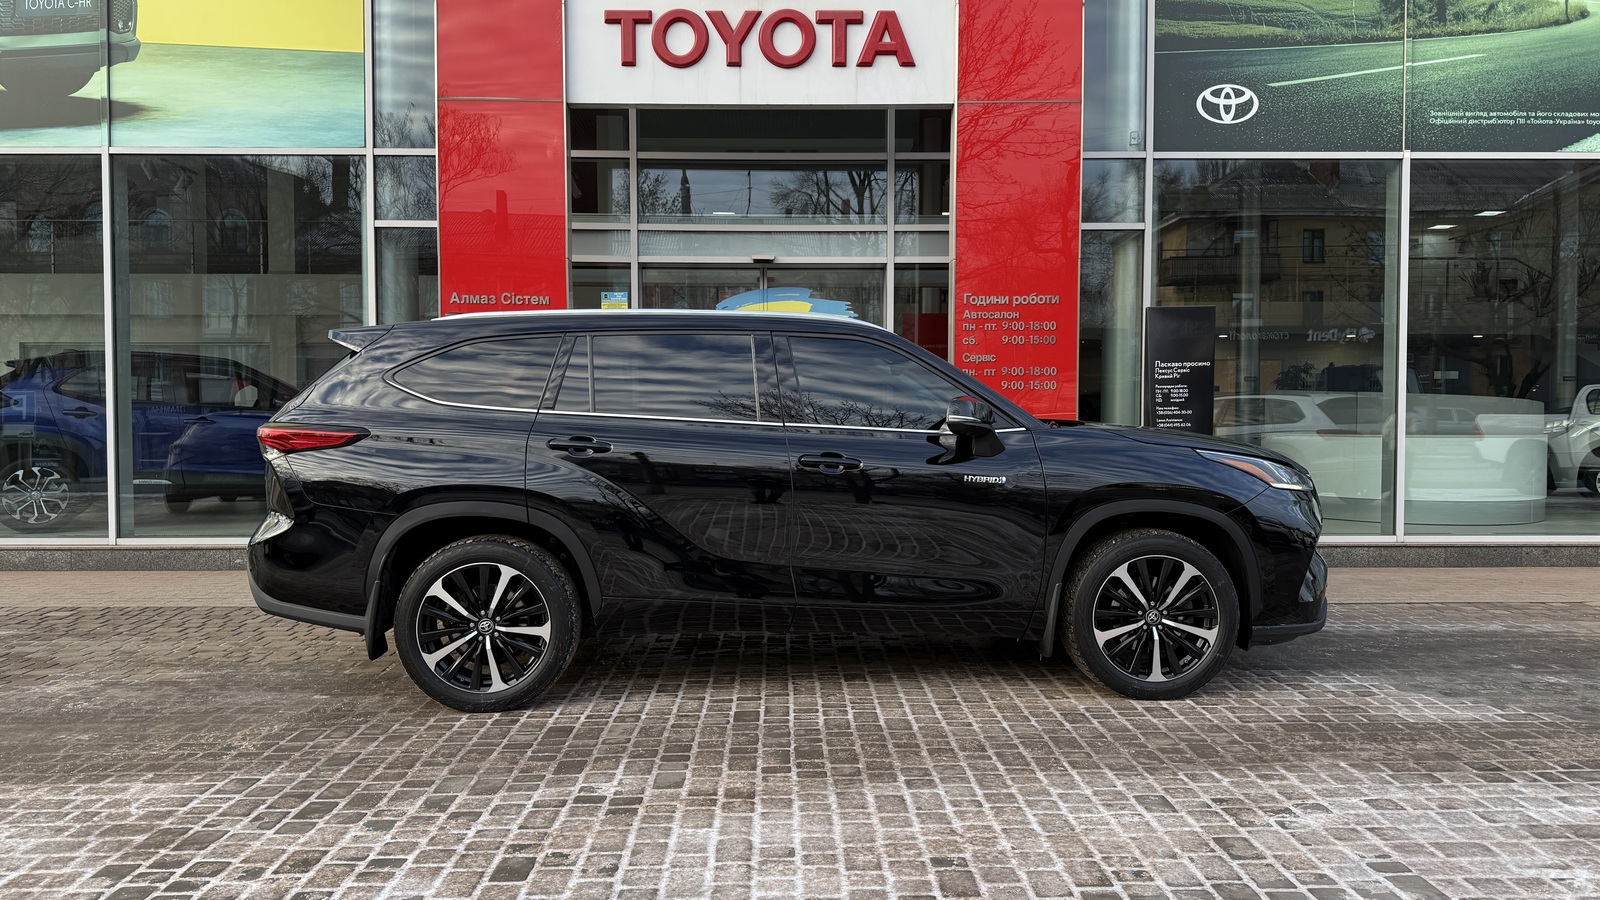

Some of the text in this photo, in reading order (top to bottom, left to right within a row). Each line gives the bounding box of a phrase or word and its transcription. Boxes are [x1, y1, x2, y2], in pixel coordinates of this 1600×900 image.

[25, 0, 65, 9] TOYOTA
[604, 8, 916, 68] TOYOTA
[450, 292, 549, 305] Алмаз Сістем
[963, 293, 1060, 307] Години роботи
[963, 310, 1020, 319] Автосалон
[962, 353, 996, 364] Сервіс
[964, 475, 1000, 483] HYBRID
